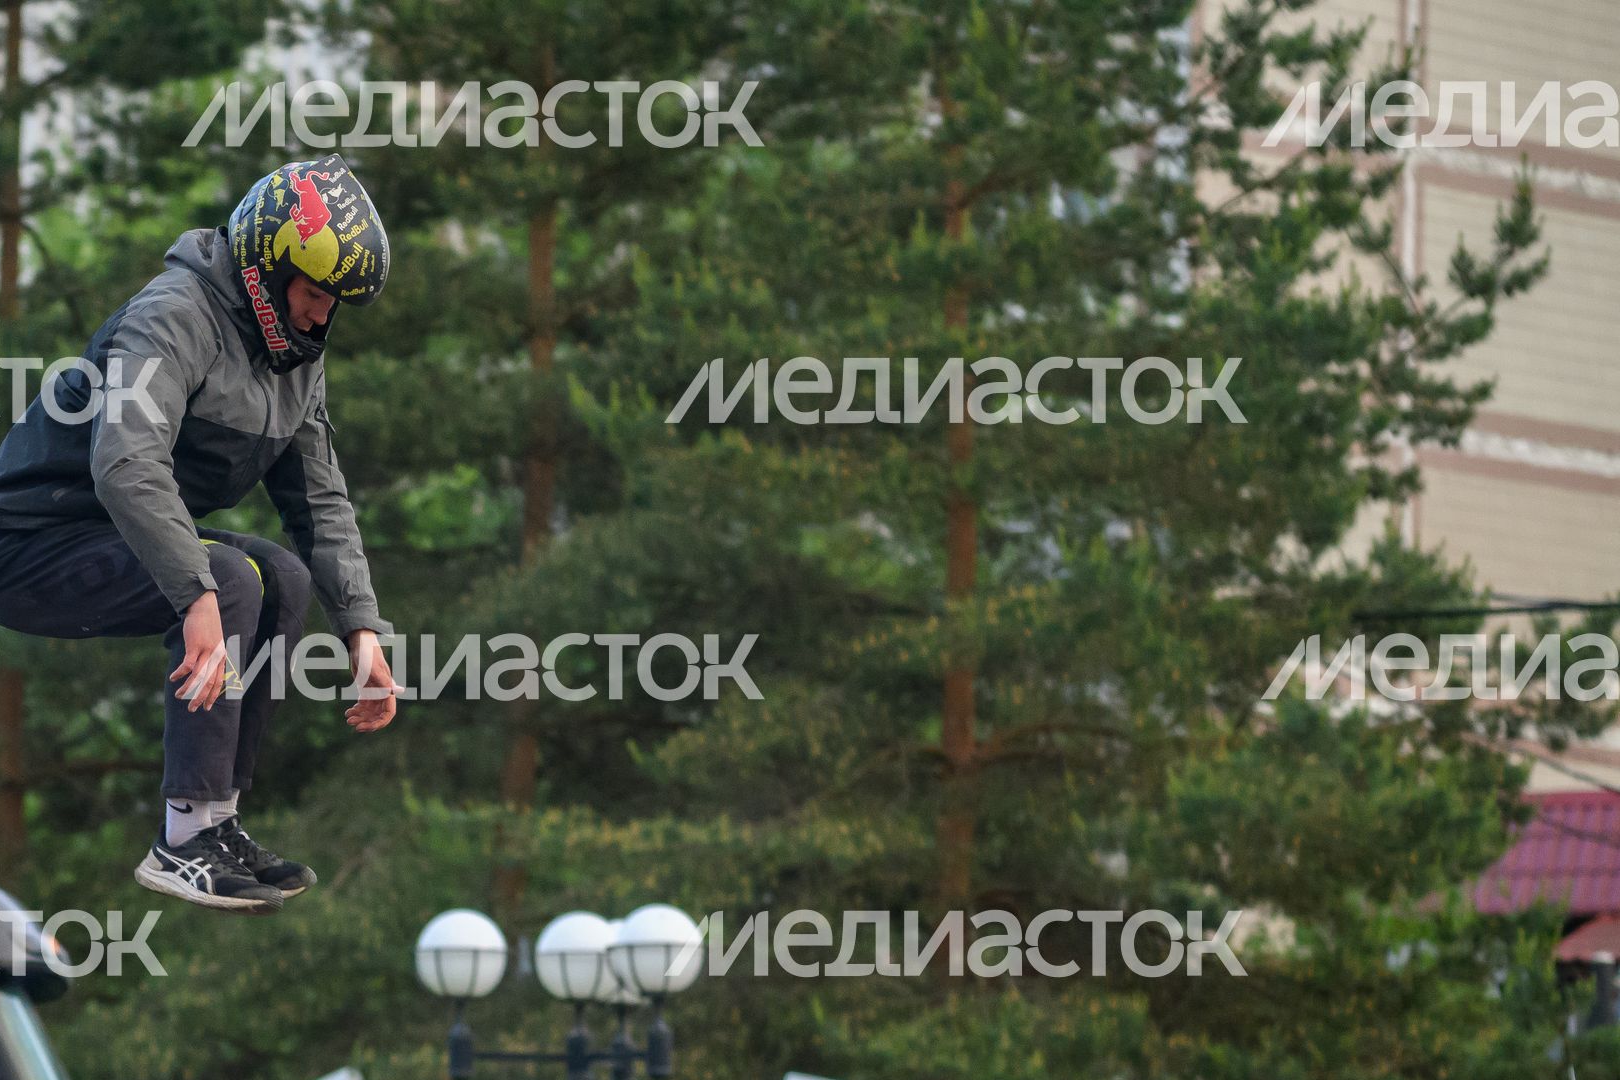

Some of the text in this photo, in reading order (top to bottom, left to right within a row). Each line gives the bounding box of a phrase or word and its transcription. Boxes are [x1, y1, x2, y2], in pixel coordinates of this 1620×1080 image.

[337, 206, 359, 231] RedBull
[339, 218, 369, 244] RedBull
[264, 235, 274, 271] RedBull
[326, 242, 364, 286] RedBull
[241, 265, 289, 351] RedBull
